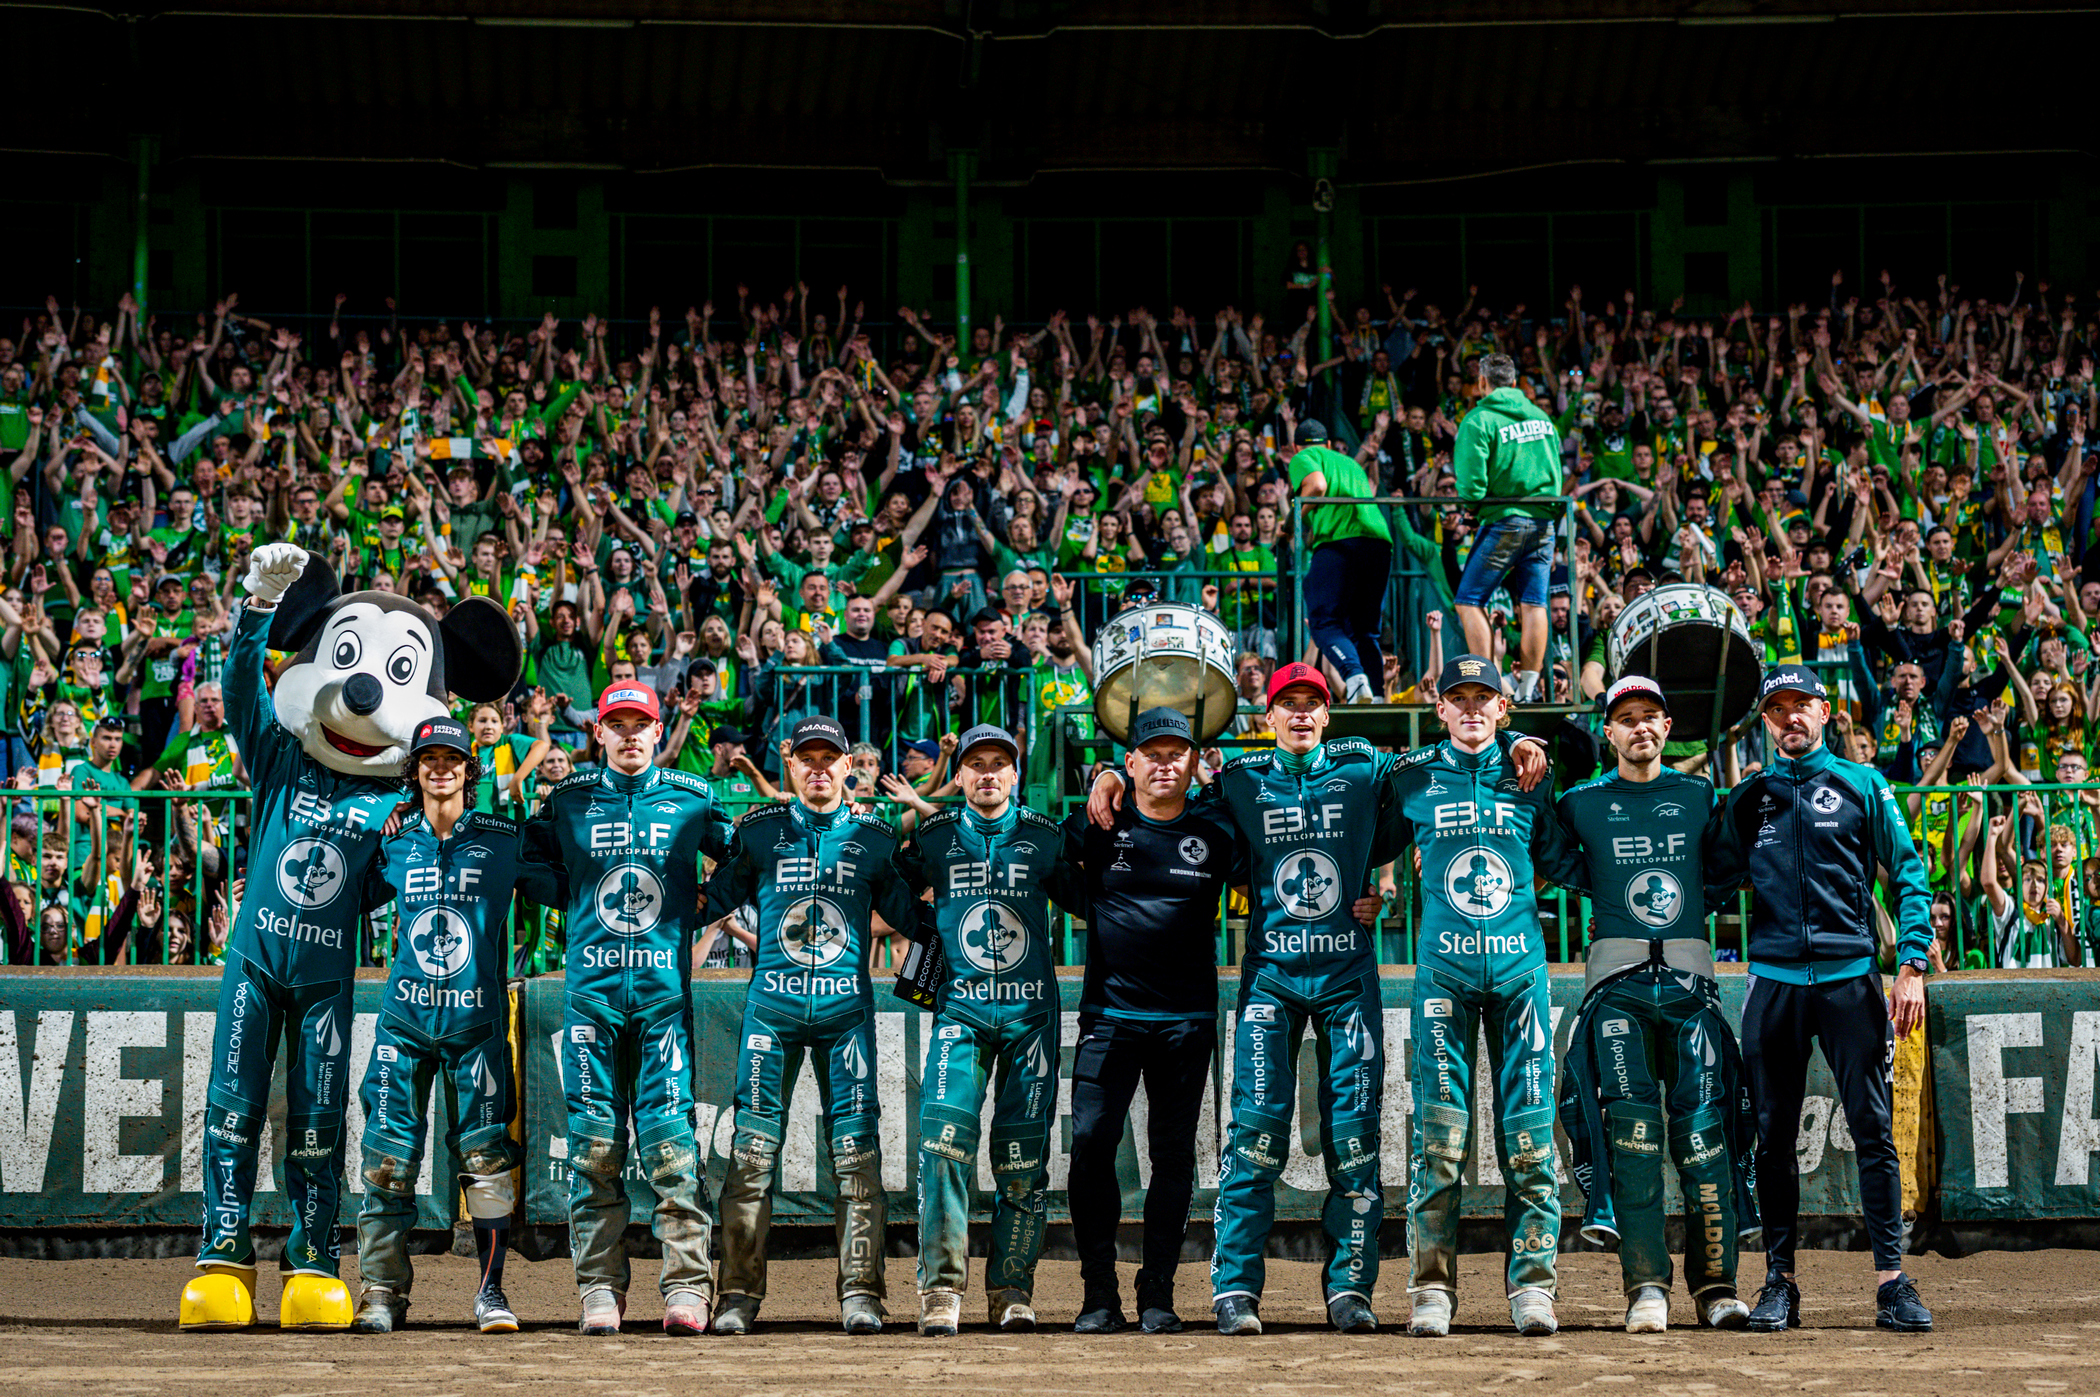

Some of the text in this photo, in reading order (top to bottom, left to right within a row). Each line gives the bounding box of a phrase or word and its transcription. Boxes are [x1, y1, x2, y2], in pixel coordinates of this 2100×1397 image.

[1499, 420, 1554, 444] FALUBAZ
[1226, 753, 1271, 770] CANAL+
[1393, 748, 1436, 772] CANAL+
[556, 772, 599, 791] CANAL+
[662, 770, 709, 793] Stelmet
[1327, 784, 1346, 793] PGE
[402, 812, 420, 827] AL+
[656, 805, 676, 815] PGE
[742, 806, 787, 823] CANAL+
[1659, 808, 1680, 818] PGE
[288, 813, 364, 842] DEVELOPMENT
[473, 814, 518, 833] Stelmet
[1435, 826, 1517, 839] DEVELOPMENT
[1265, 830, 1345, 845] DEVELOPMENT
[466, 849, 488, 859] PGE
[590, 848, 671, 858] DEVELOPMENT
[842, 845, 861, 856] PGE
[1014, 845, 1034, 855] PGE
[1616, 855, 1687, 866] DEVELOPMENT
[405, 894, 481, 903] DEVELOPMENT
[775, 884, 856, 897] DEVELOPMENT
[950, 889, 1030, 899] DEVELOPMENT
[254, 907, 344, 950] Stelmet
[1264, 929, 1357, 954] Stelmet
[1438, 930, 1529, 955] Stelmet
[582, 944, 674, 970] Stelmet
[917, 934, 939, 989] ECCOPROFI
[395, 979, 485, 1009] Stelmet
[763, 971, 861, 996] Stelmet
[953, 977, 1045, 1002] Stelmet
[227, 981, 250, 1074] ZIELONA GÓRA
[575, 1028, 588, 1041] pl
[1607, 1022, 1624, 1034] pl
[936, 1026, 960, 1101] samochody pl
[1250, 1006, 1268, 1107] samochody pl
[1430, 1002, 1452, 1103] samochody pl
[323, 1061, 335, 1106] Lubuskie
[749, 1035, 765, 1112] amochody pl
[1531, 1057, 1544, 1106] Lubuskie
[317, 1080, 325, 1105] zachodu
[378, 1047, 393, 1130] samochody pl
[1360, 1066, 1371, 1112] Lubuskie
[1525, 1078, 1533, 1106] zachodu
[1029, 1082, 1044, 1119] Lubuskie
[485, 1101, 495, 1128] Lubus
[208, 1124, 249, 1146] AMRHEIN
[1614, 1137, 1661, 1152] AMRHEIN
[290, 1146, 334, 1159] AMRHEIN
[733, 1147, 774, 1167] AMRHEIN
[835, 1148, 878, 1169] AMRHEIN
[923, 1139, 967, 1160] AMRHEIN
[1237, 1145, 1281, 1167] AMRHEIN
[1336, 1151, 1378, 1171] AMRHEIN
[1683, 1143, 1725, 1166] AMRHEIN
[651, 1153, 695, 1180] AMRHEIN
[996, 1158, 1040, 1173] AMRHEIN
[304, 1182, 319, 1230] ZIELONA
[1008, 1211, 1022, 1253] WRÓBEL
[1699, 1183, 1725, 1278] MOLDOW
